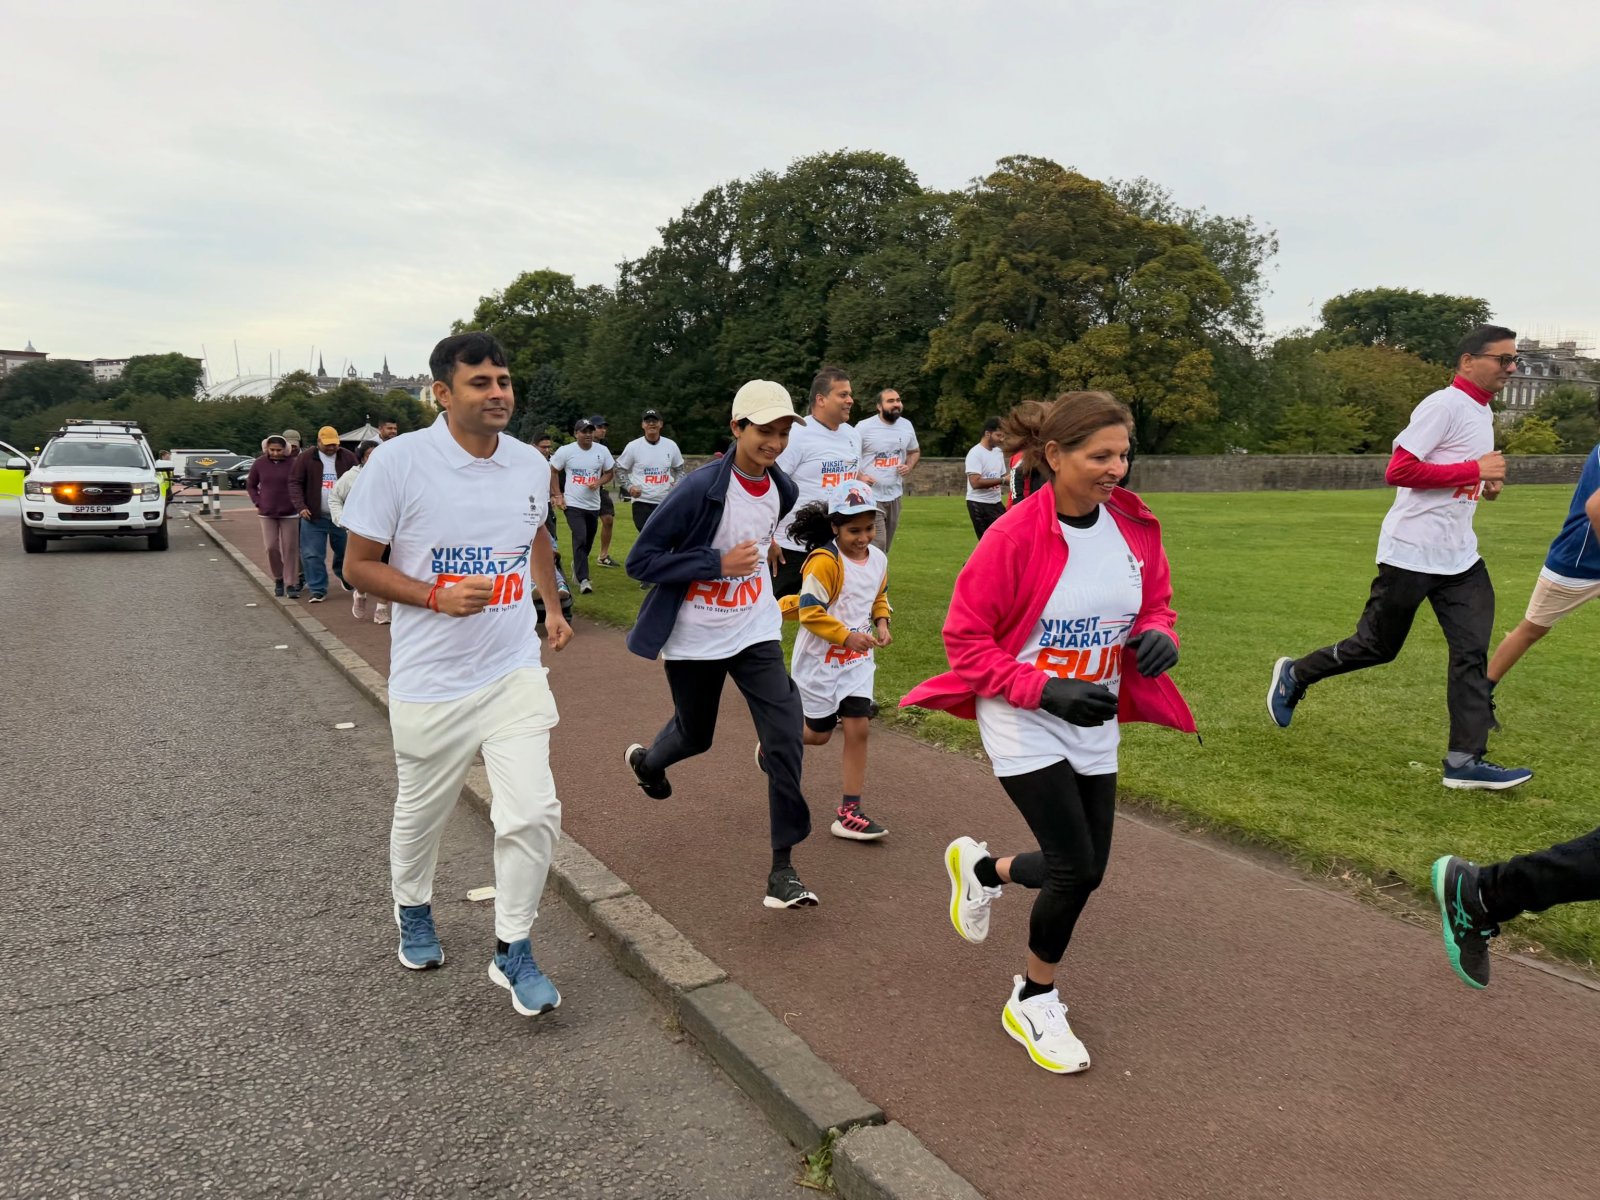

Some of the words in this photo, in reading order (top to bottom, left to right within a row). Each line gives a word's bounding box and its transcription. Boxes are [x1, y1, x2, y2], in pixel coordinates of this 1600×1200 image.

[821, 460, 844, 468] VIKSIT
[874, 456, 899, 468] RUN
[821, 465, 848, 474] BHARAT
[645, 475, 669, 484] RUN
[431, 547, 493, 561] VIKSIT
[432, 560, 507, 574] BHARAT
[686, 576, 762, 608] RUN
[1040, 616, 1101, 634] VIKSIT
[1038, 631, 1113, 648] BHARAT
[1035, 645, 1121, 682] RUN
